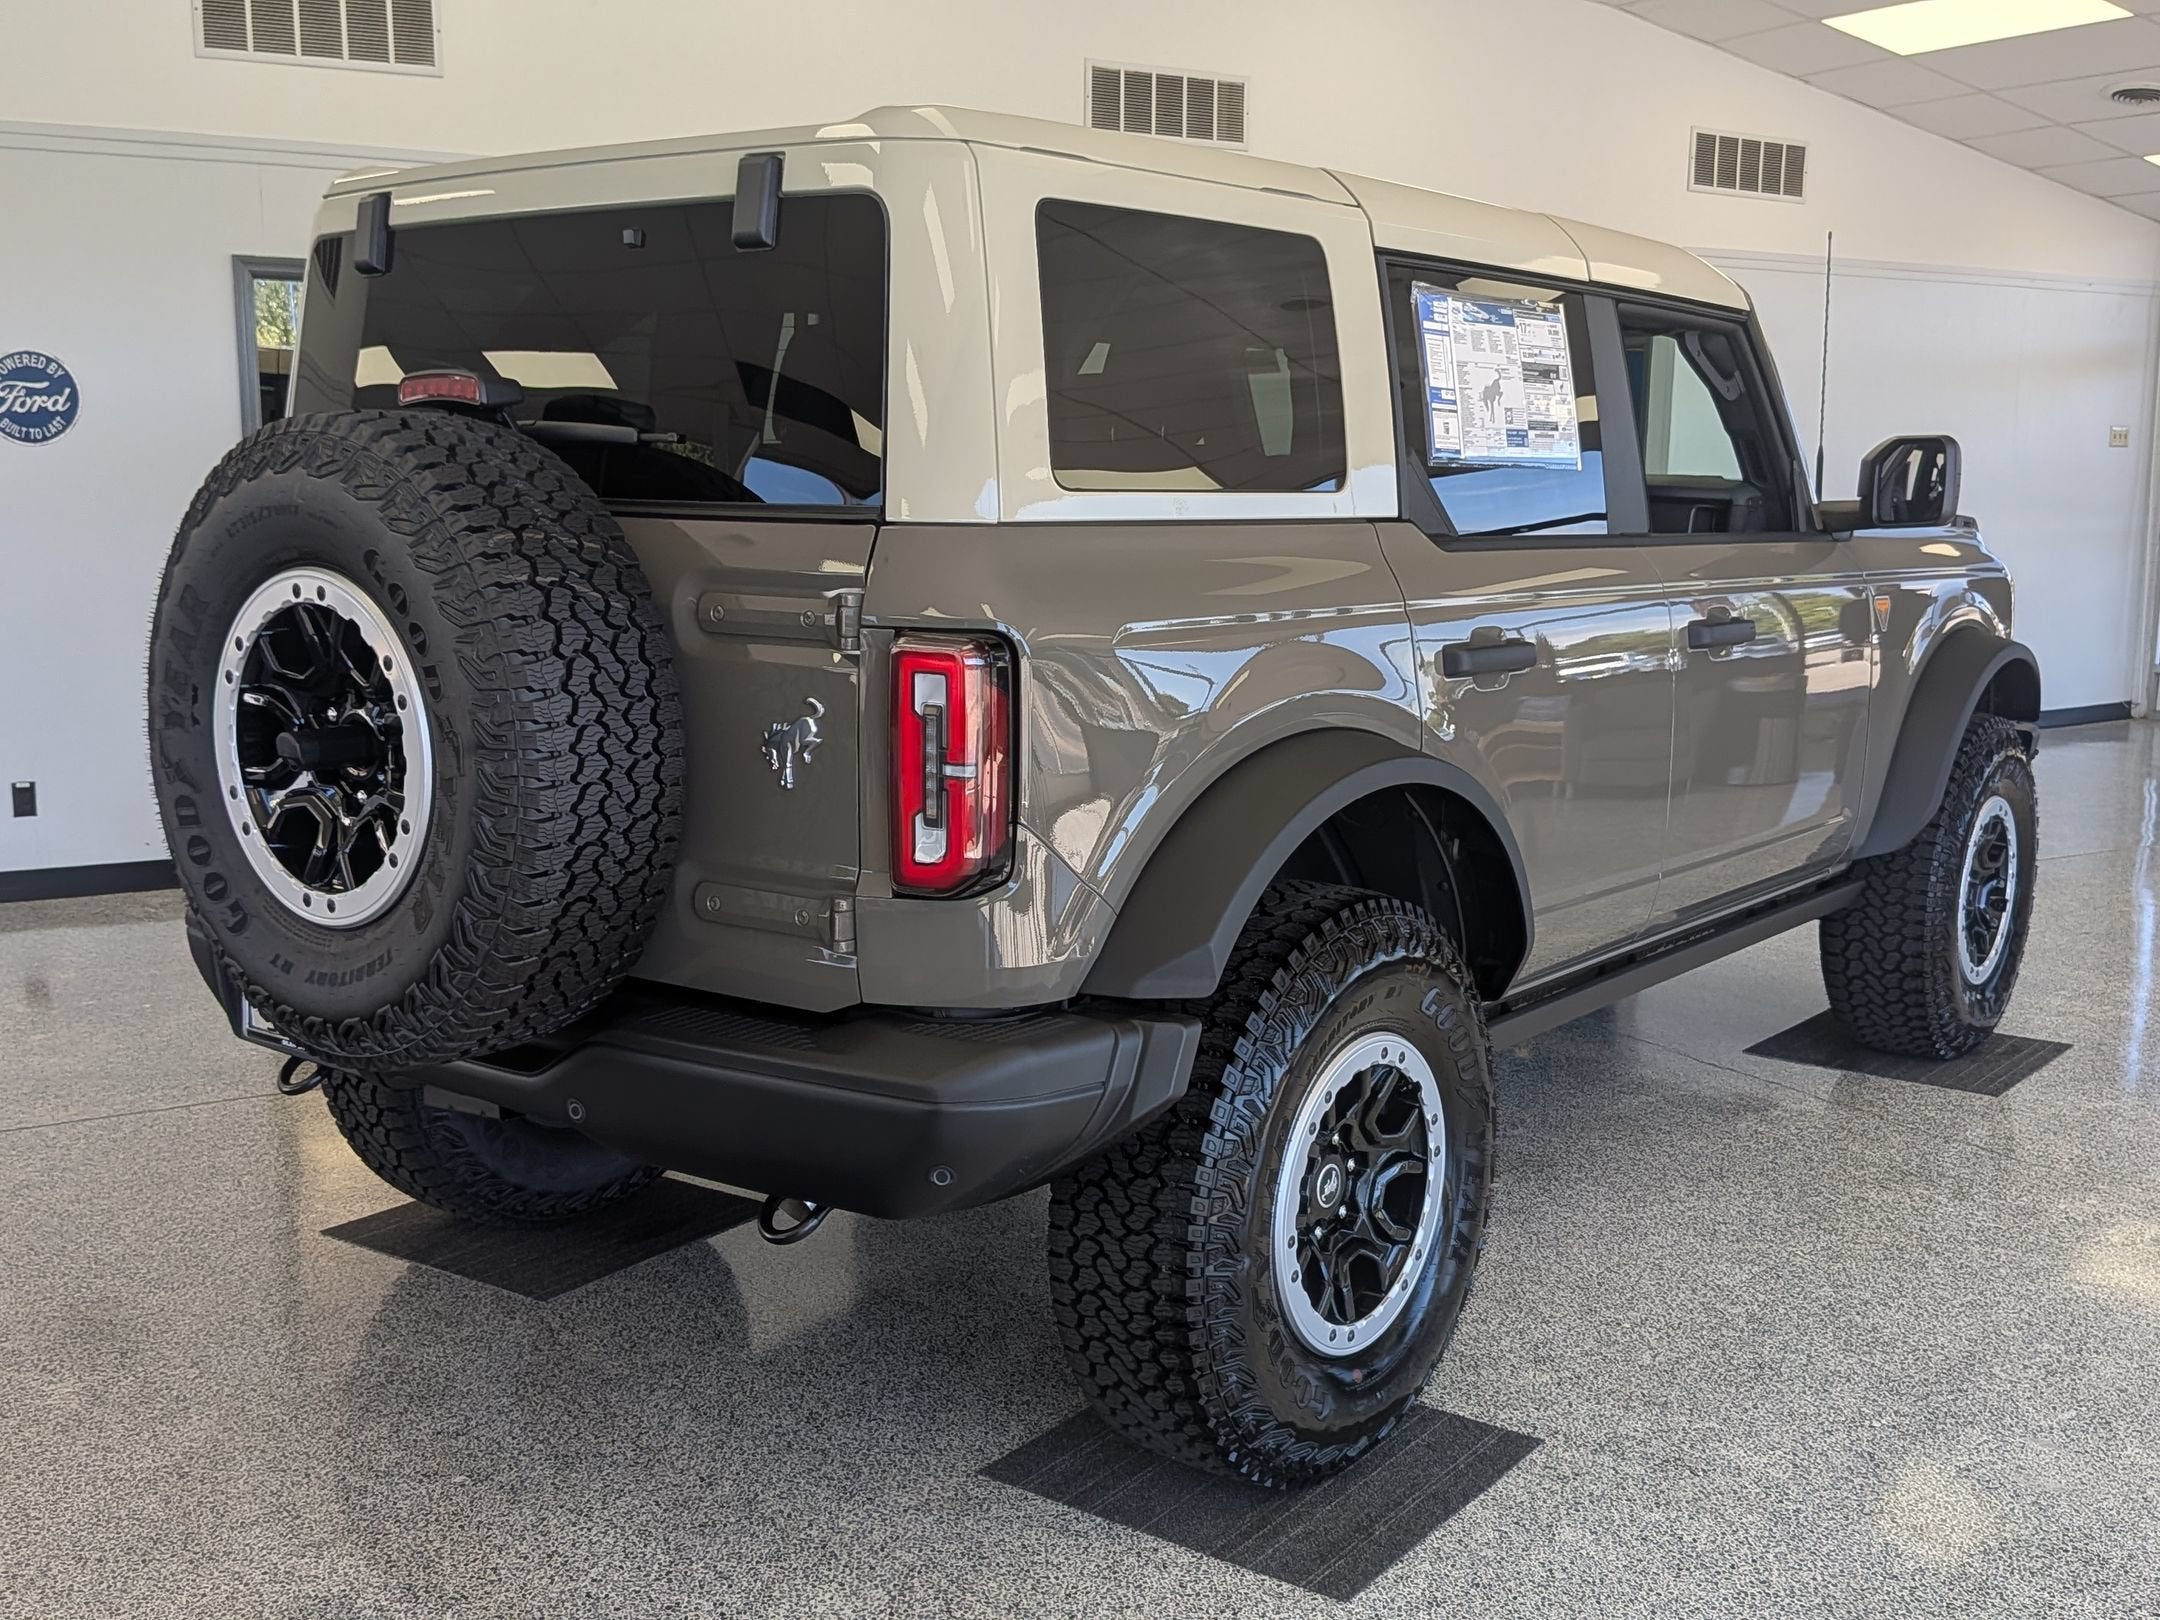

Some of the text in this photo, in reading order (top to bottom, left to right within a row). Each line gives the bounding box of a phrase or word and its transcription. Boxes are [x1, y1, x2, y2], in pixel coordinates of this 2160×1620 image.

[0, 353, 66, 380] OWERED BY
[0, 380, 71, 414] Ford
[0, 415, 67, 440] BUILT TO LAST
[268, 947, 394, 988] TERRITORY RT
